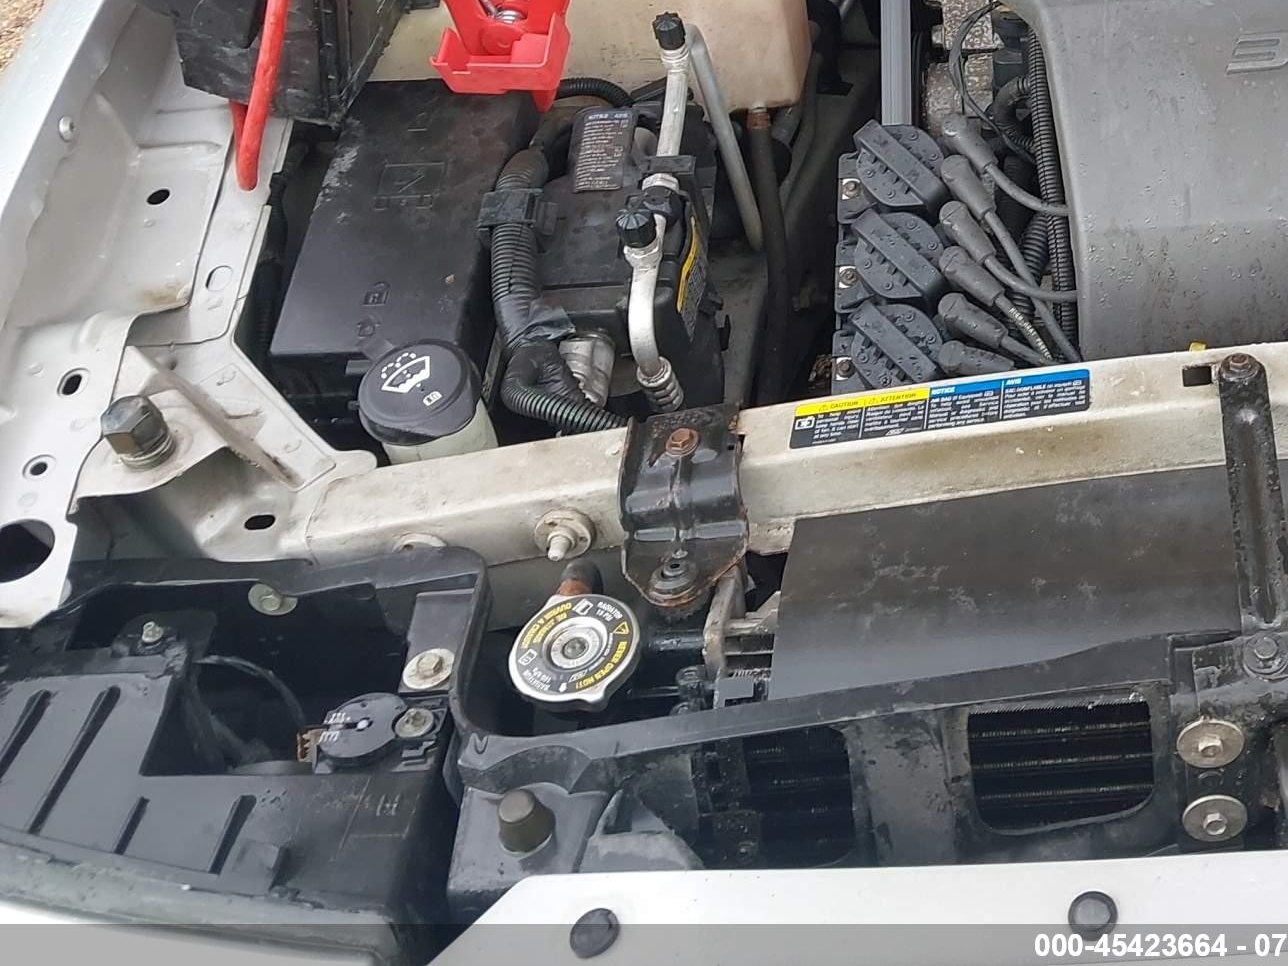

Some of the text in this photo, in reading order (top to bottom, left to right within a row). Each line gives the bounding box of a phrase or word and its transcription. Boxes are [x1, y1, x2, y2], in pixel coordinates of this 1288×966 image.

[1005, 378, 1021, 386] AVIS
[932, 386, 955, 395] NOTICE
[880, 393, 916, 402] ATTENTION
[830, 401, 858, 409] CAUTION
[612, 640, 628, 664] NEVER
[594, 662, 615, 681] OPEN
[575, 674, 595, 690] HOT!
